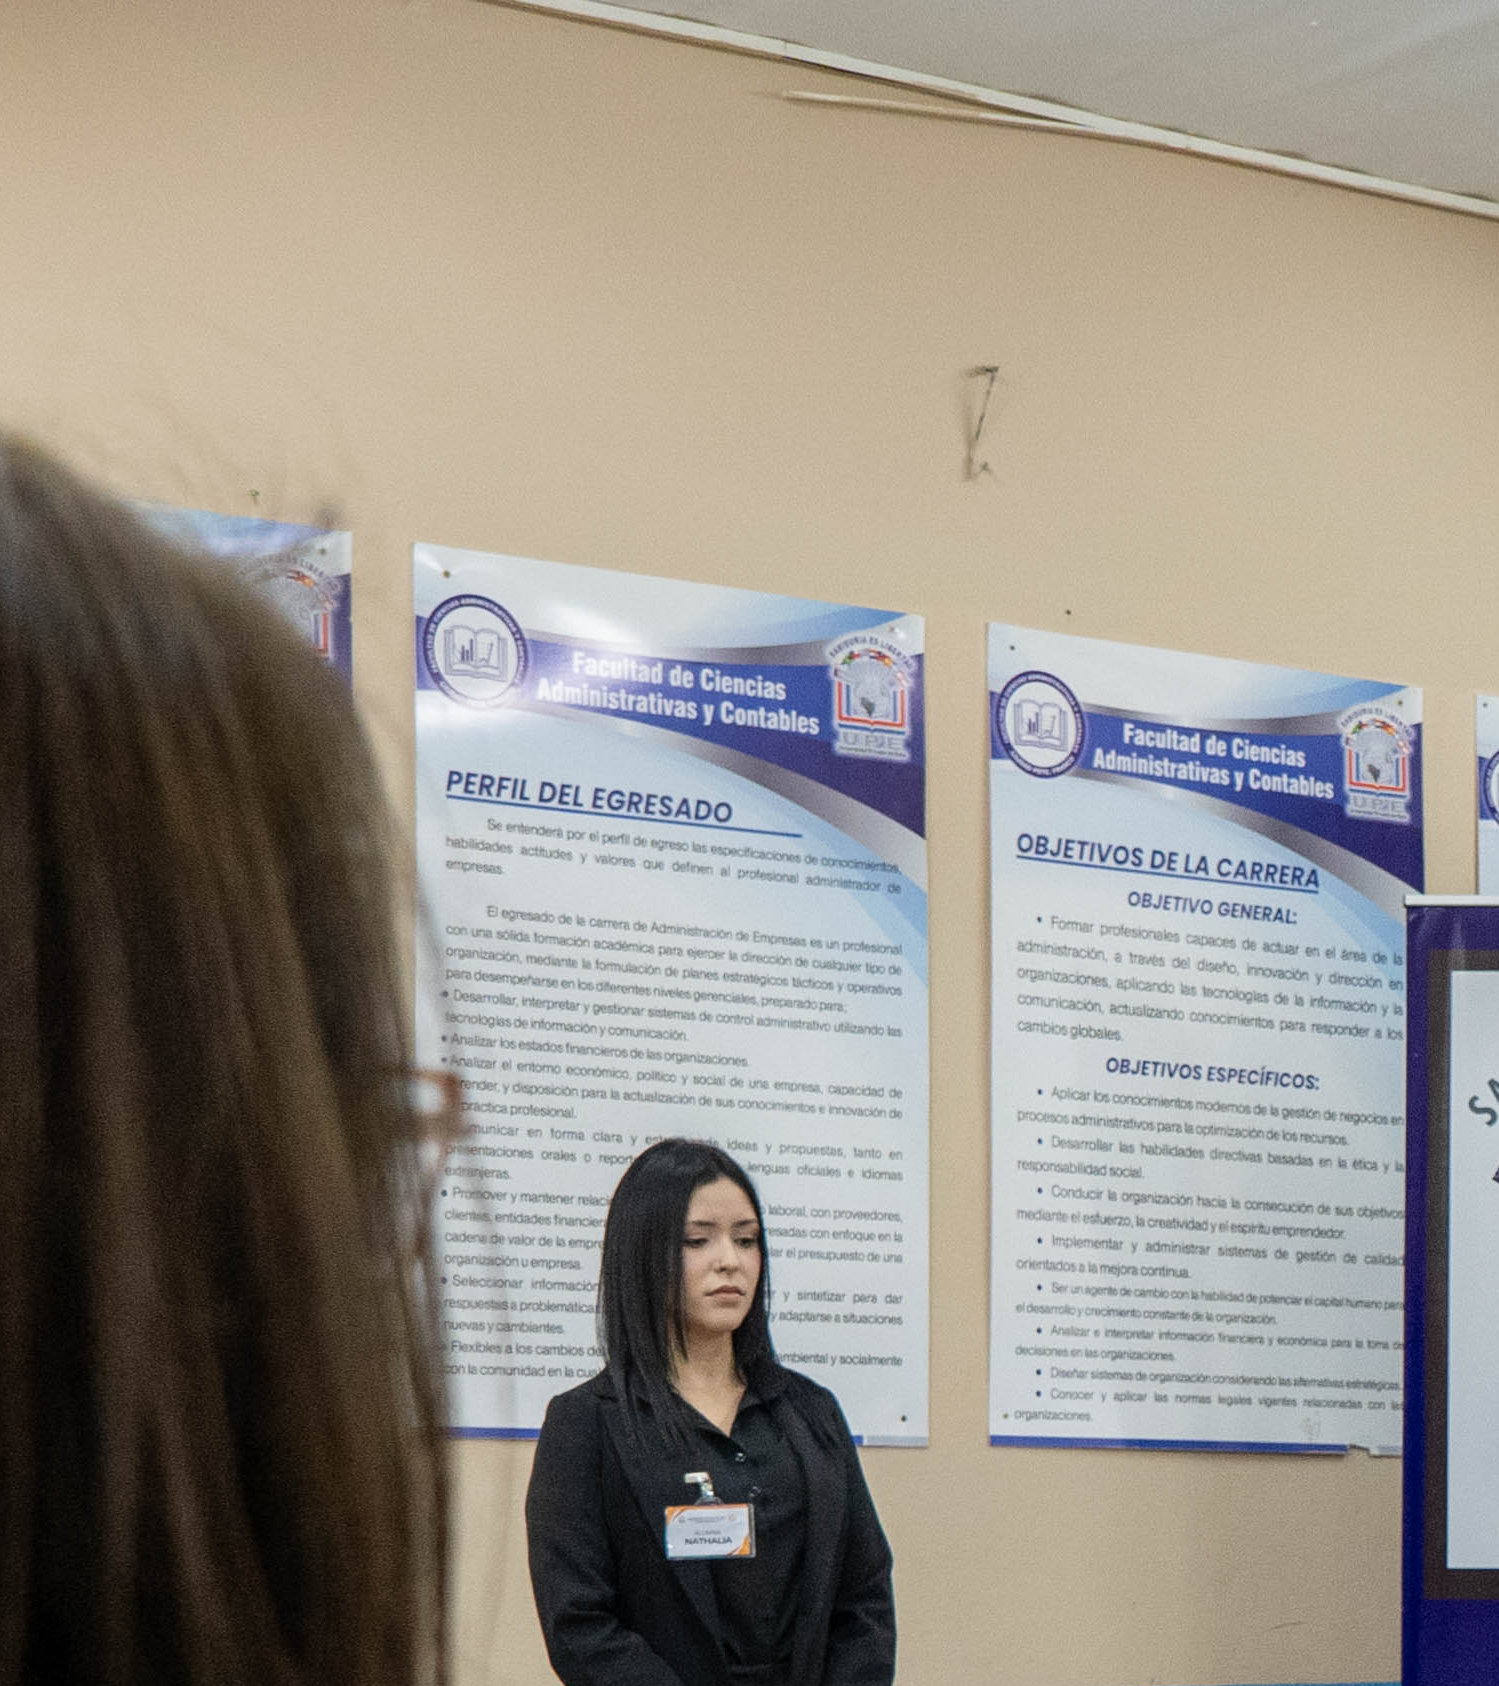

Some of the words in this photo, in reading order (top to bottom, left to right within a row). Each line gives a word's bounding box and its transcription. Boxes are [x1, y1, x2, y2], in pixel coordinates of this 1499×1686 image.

[571, 651, 664, 686] Facultad
[669, 663, 694, 688] de
[699, 667, 788, 701] Ciencias
[536, 676, 698, 721] Administrativas
[702, 703, 716, 727] y
[719, 701, 821, 736] Contables
[1122, 722, 1201, 754] Facultad
[1205, 734, 1228, 757] de
[1231, 736, 1307, 768] Ciencias
[446, 769, 532, 803] PERFIL
[538, 779, 586, 808] DEL
[590, 786, 734, 824] EGRESADO
[1092, 747, 1231, 786] Administrativas
[1234, 769, 1245, 792] y
[1248, 768, 1336, 800] Contables
[1017, 832, 1144, 868] OBJETIVOS
[1150, 848, 1178, 870] DE
[1184, 854, 1210, 876] LA
[1216, 857, 1321, 888] CARRERA
[1127, 890, 1214, 915] OBJETIVO
[1217, 900, 1299, 925] GENERAL:
[1105, 1056, 1202, 1081] OBJETIVOS
[1207, 1064, 1321, 1092] ESPECÍFICOS:
